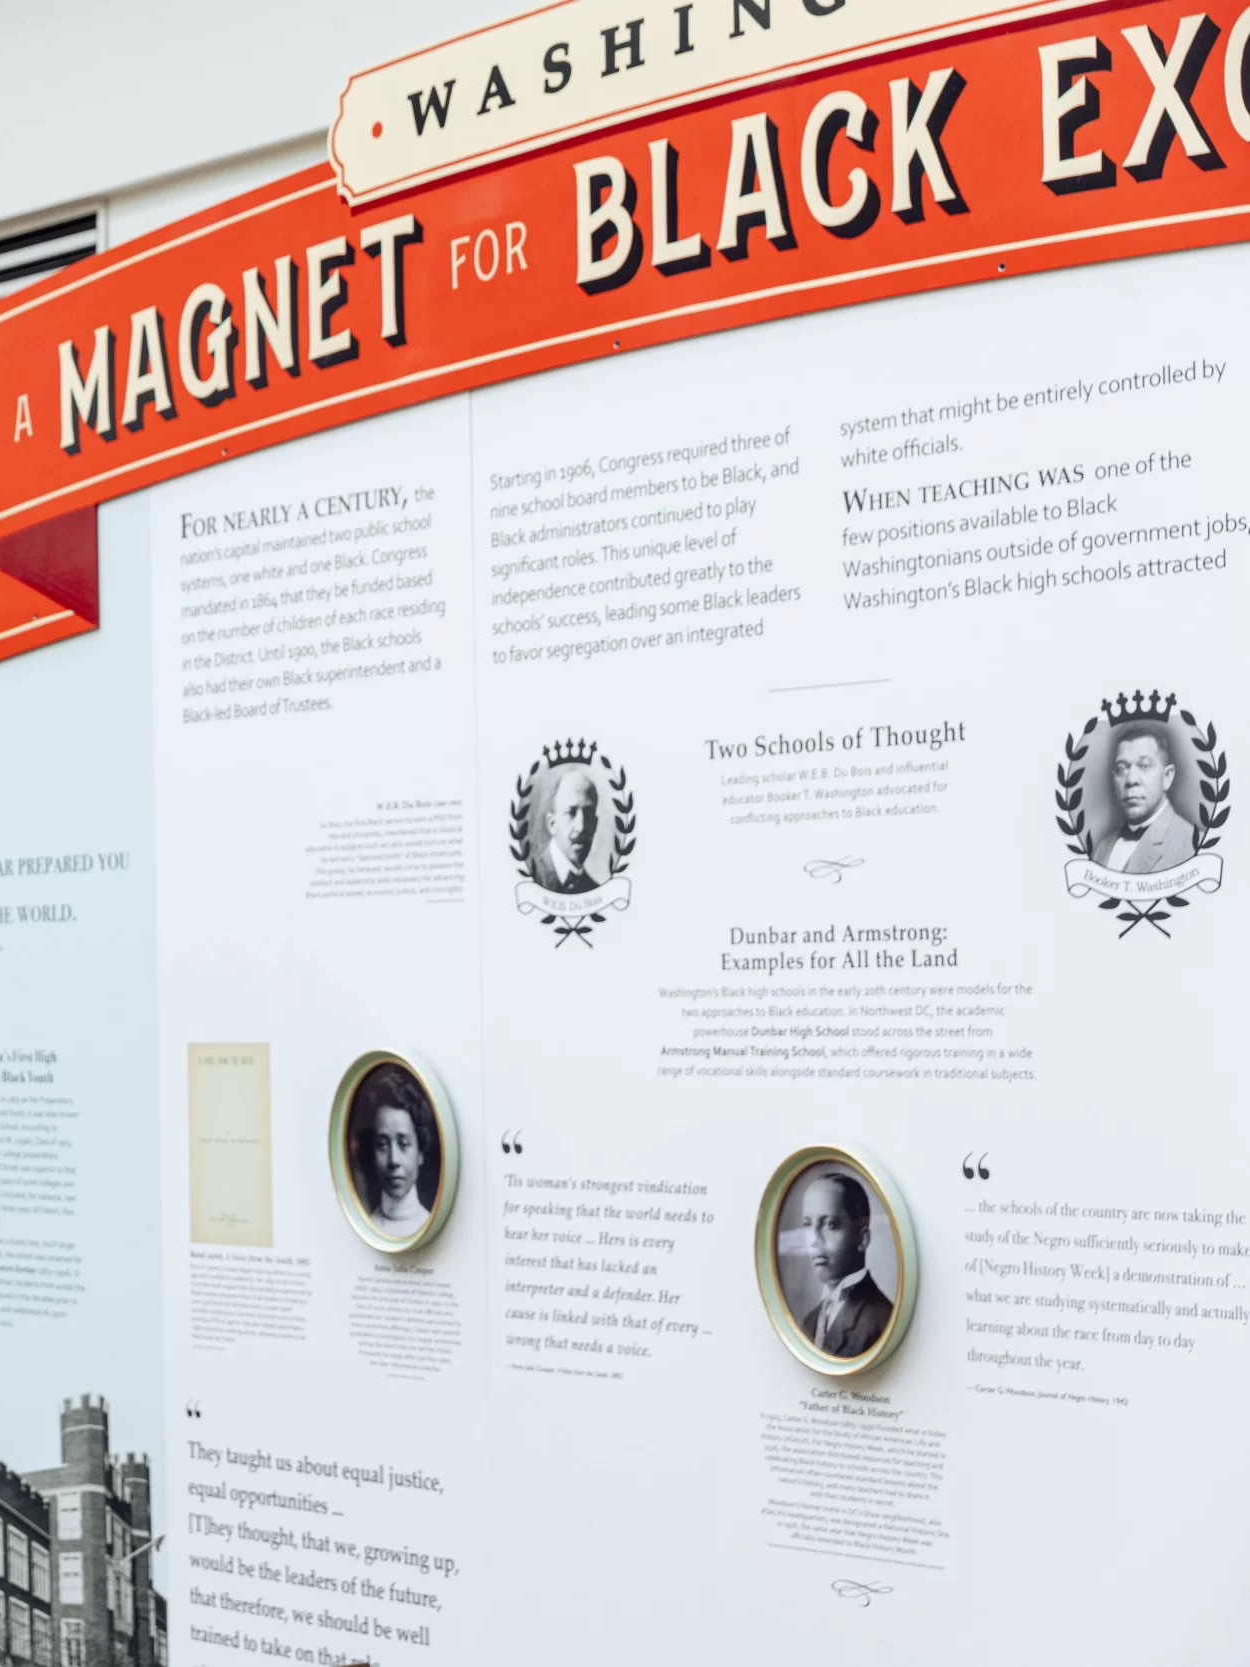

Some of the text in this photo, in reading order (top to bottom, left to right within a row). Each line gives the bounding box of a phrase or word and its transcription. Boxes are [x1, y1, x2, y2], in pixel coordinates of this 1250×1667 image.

[13, 393, 34, 442] A
[58, 214, 424, 455] MAGNET
[449, 221, 528, 290] FOR
[573, 67, 971, 295] BLACK
[841, 359, 1226, 440] system that might be entirely controlled by
[491, 468, 542, 490] Starting
[544, 465, 556, 482] in
[598, 452, 664, 474] Congress
[666, 437, 727, 465] required
[731, 434, 771, 453] three
[774, 425, 791, 446] of
[841, 433, 962, 467] white officials.
[491, 458, 799, 519] nine school board members to be Black, and
[843, 450, 1191, 514] WHEN TEACHING WAS one of the
[181, 486, 435, 539] FOR NEARLY A CENTURY, the
[843, 492, 1117, 548] few positions available to Black
[843, 545, 982, 577] Washingtonians
[986, 535, 1053, 561] outside
[1058, 531, 1076, 553] of
[1081, 520, 1200, 556] government
[844, 548, 1226, 609] Washington's Black high schools attracted
[706, 721, 966, 759] Two Schools of Thought
[721, 772, 759, 787] Leading
[761, 769, 796, 783] scholar
[833, 765, 848, 778] Du
[850, 764, 872, 777] Bois
[874, 762, 893, 775] and
[896, 758, 948, 773] influential
[17, 855, 93, 875] PREPARED
[98, 853, 130, 871] YOU
[1083, 869, 1119, 892] Booker
[1136, 866, 1200, 892] Washington
[17, 904, 77, 923] WORLD.
[731, 924, 947, 945] Dunbar and Armstrong:
[722, 948, 958, 975] Examples for All the Land
[502, 1200, 714, 1222] for speaking that the world needs to
[965, 1228, 994, 1247] study
[997, 1230, 1009, 1243] of
[1011, 1230, 1029, 1245] the
[1033, 1231, 1070, 1250] Negro
[1073, 1234, 1139, 1255] sufficiently
[1143, 1238, 1197, 1258] seriously
[1201, 1243, 1214, 1255] to
[967, 1348, 1084, 1373] throughout the year.
[188, 1440, 444, 1495] They taught us about equal justice,
[237, 1523, 297, 1551] thought,
[301, 1533, 330, 1553] that
[334, 1542, 359, 1561] we,
[363, 1547, 430, 1573] growing
[433, 1557, 459, 1577] up,
[190, 1555, 441, 1611] would be the leaders of the future,
